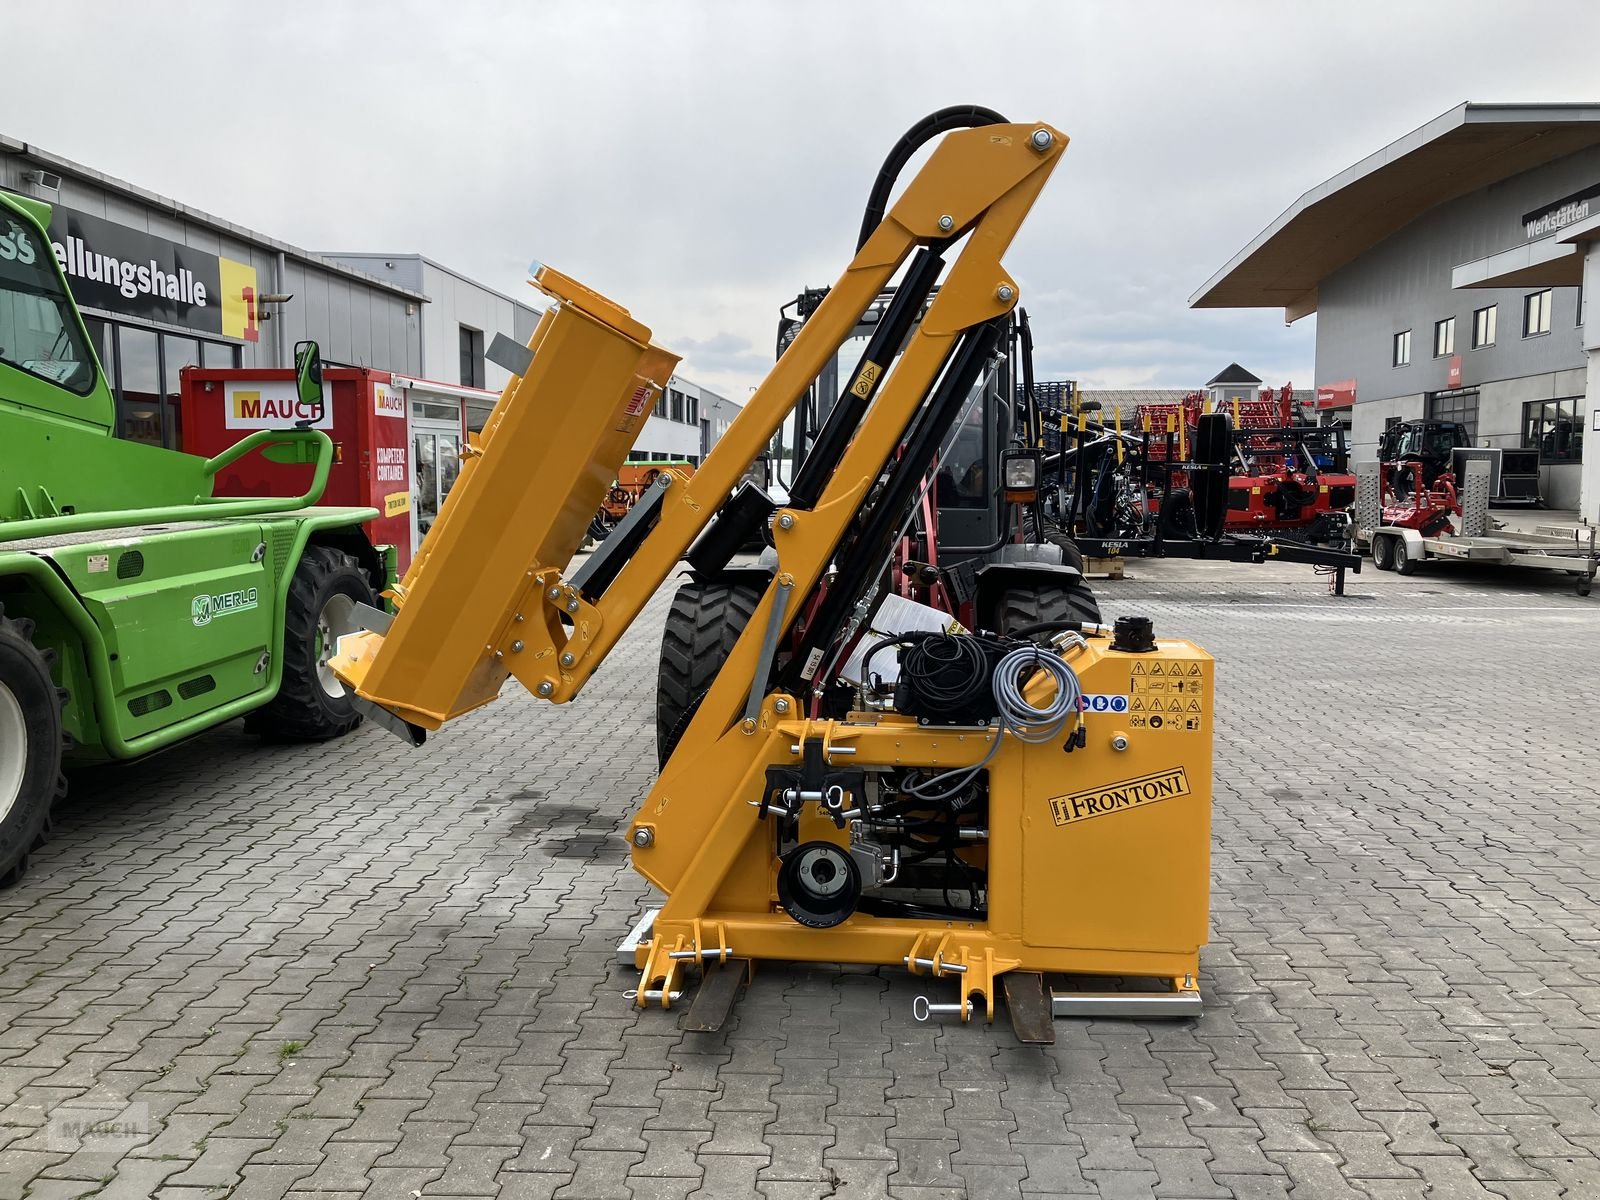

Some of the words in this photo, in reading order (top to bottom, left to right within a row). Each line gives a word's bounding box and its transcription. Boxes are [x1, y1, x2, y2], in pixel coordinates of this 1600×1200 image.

[1526, 202, 1589, 239] Werkstätten
[242, 286, 259, 343] 1
[379, 395, 403, 412] MAUCH
[1041, 420, 1061, 432] ESLA
[376, 447, 405, 464] KOMPETENZ
[377, 465, 404, 481] CONTAINER
[212, 587, 257, 611] MERLO
[1068, 770, 1184, 819] FRONTONI
